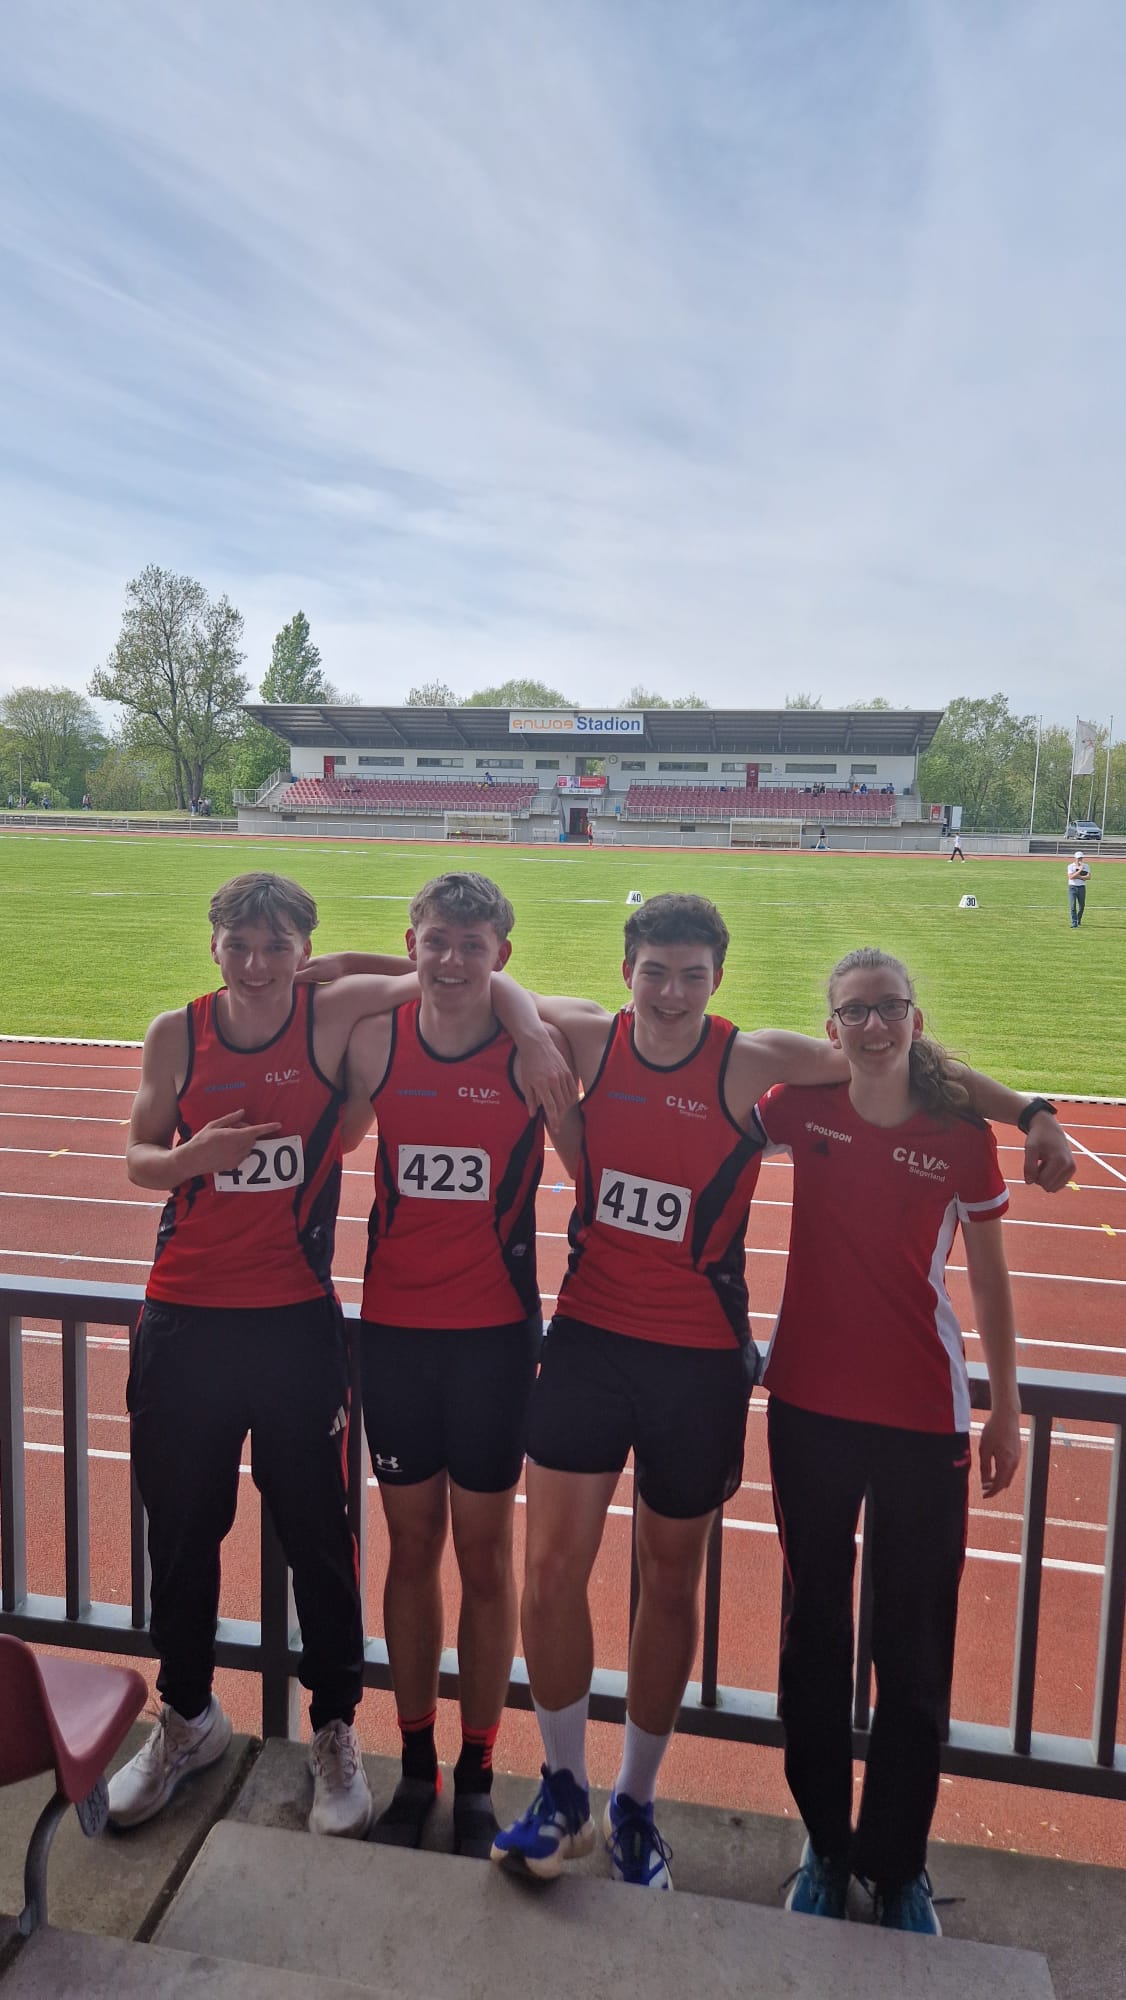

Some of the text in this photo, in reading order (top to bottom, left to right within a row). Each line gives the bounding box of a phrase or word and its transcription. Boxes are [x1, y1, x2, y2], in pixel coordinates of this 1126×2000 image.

[576, 716, 641, 731] Stadion
[966, 897, 976, 907] 30
[813, 1124, 852, 1143] POLYGON
[403, 1153, 484, 1193] 423
[909, 1166, 945, 1182] Siegerland
[602, 1181, 682, 1231] 419
